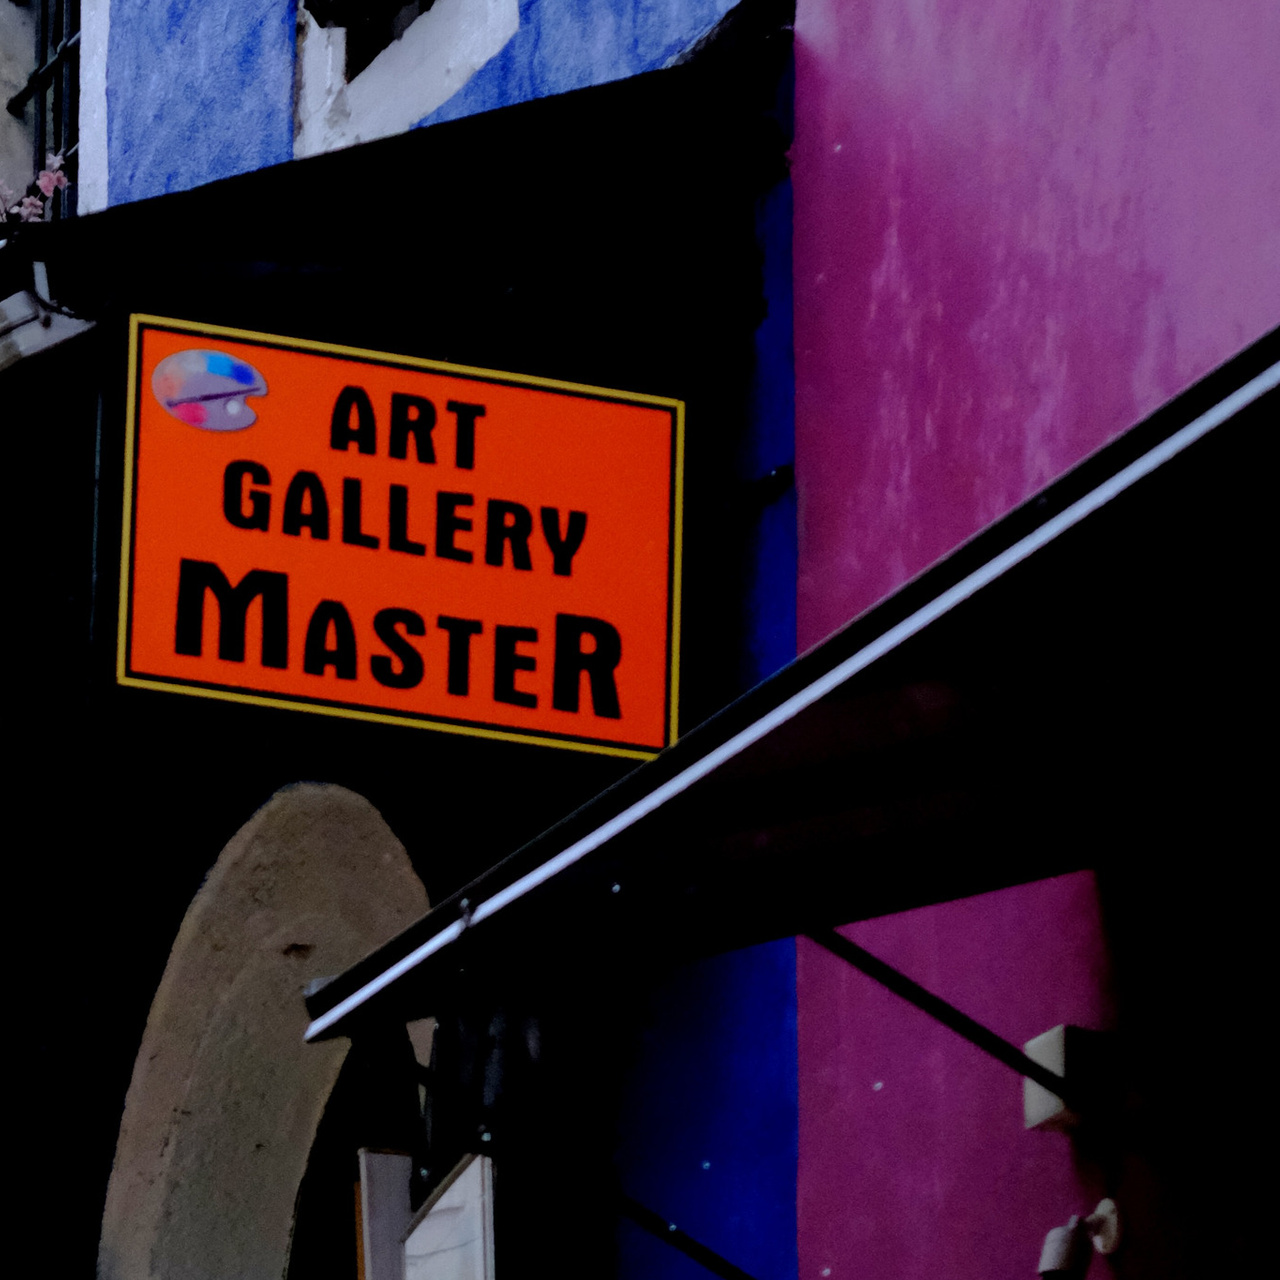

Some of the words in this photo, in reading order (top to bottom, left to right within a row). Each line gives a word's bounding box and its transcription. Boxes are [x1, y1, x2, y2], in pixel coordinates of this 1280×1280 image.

[330, 384, 487, 471] ART
[222, 458, 588, 577] GALLERY
[174, 557, 623, 720] MASTER
